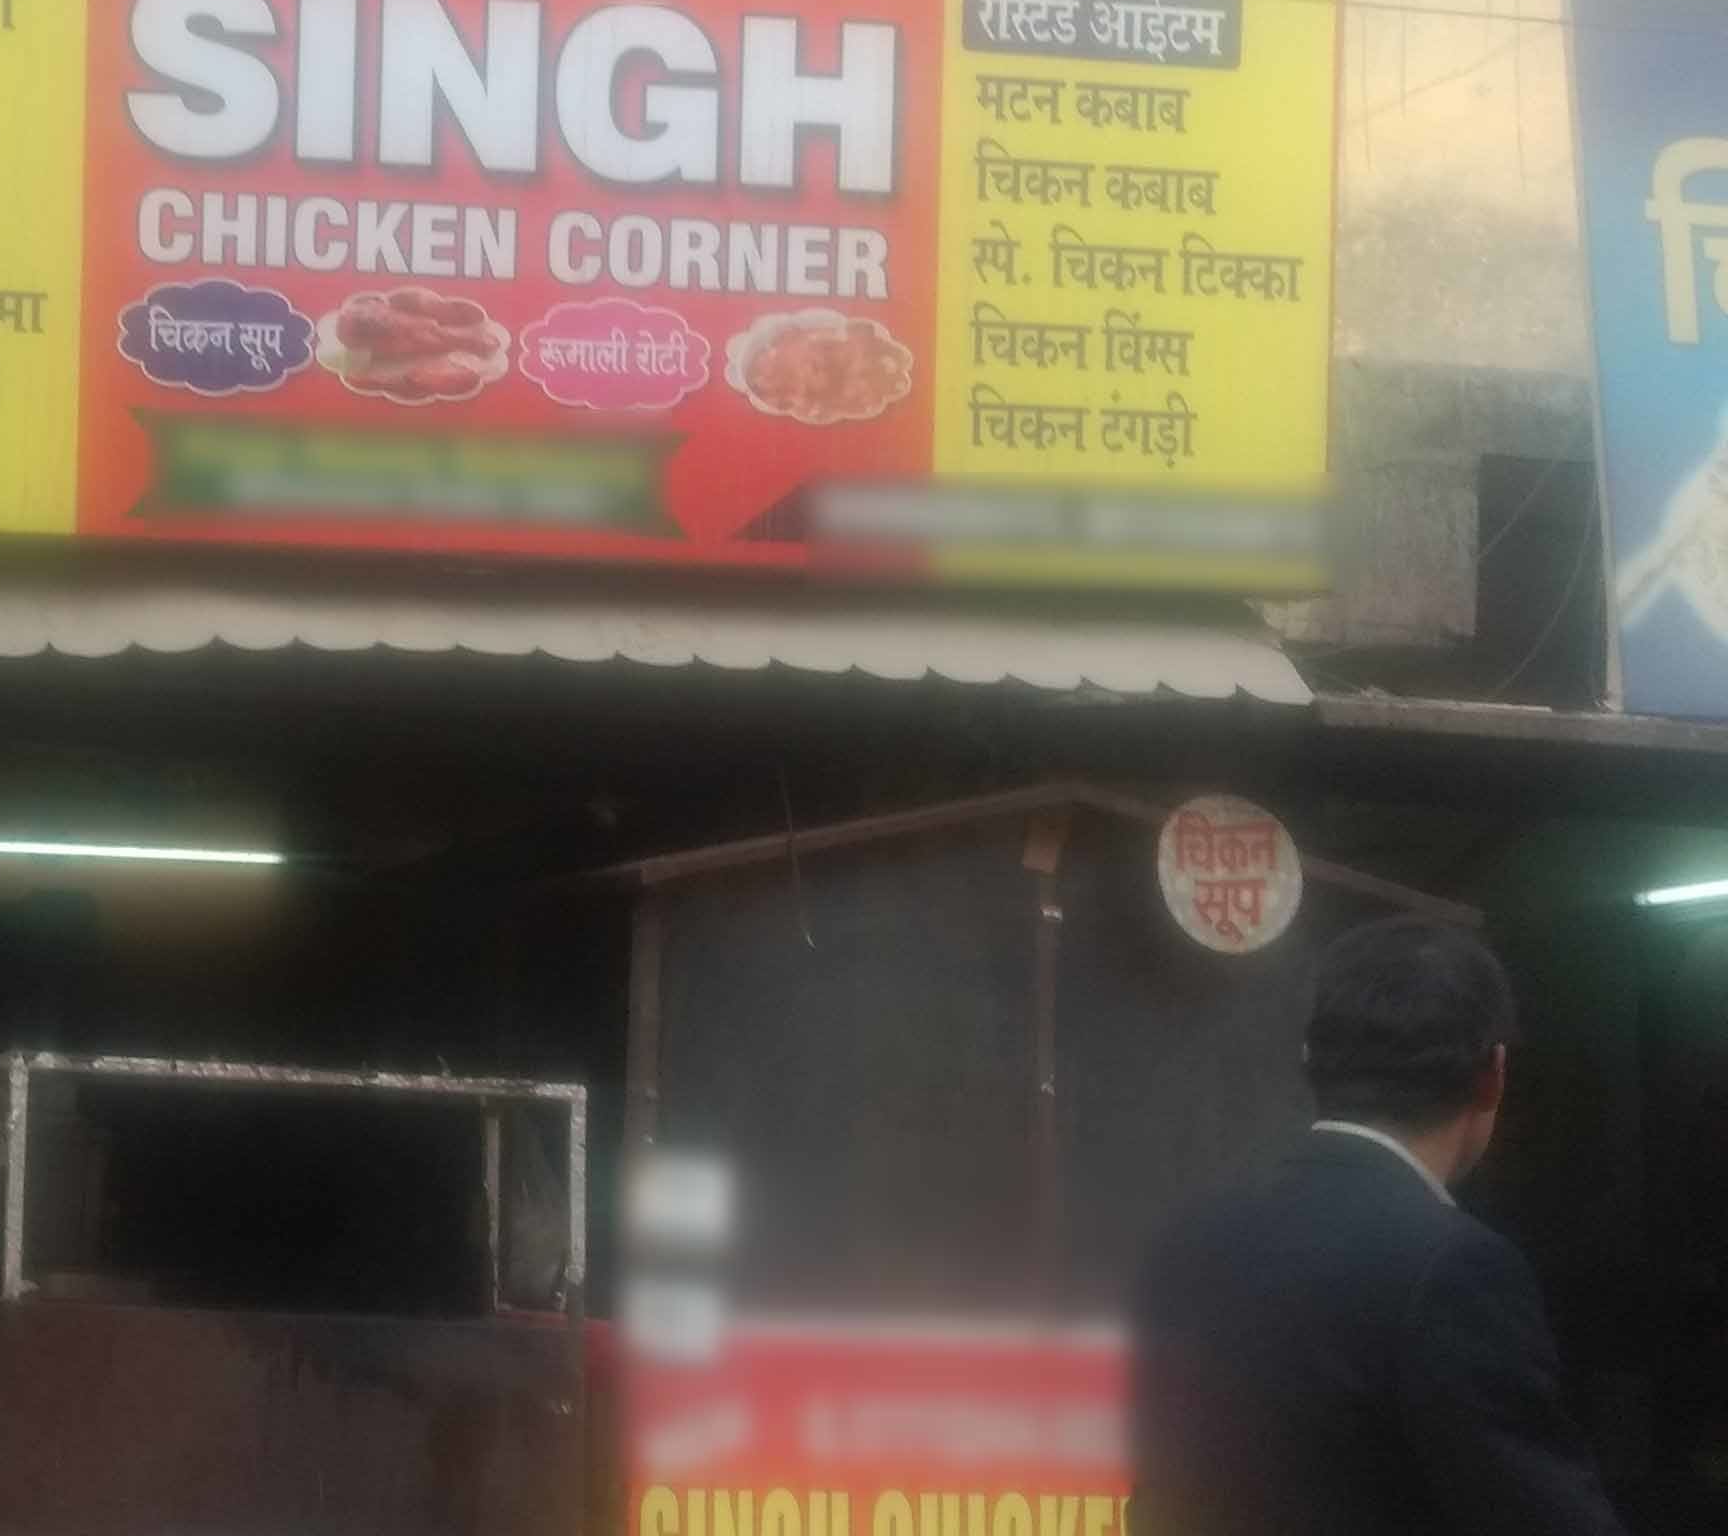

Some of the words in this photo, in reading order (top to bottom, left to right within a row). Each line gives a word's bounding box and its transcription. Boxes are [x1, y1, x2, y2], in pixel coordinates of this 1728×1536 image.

[975, 73, 1067, 125] मटन
[1075, 80, 1191, 135] कबाब
[974, 140, 1094, 209] चिकन
[1105, 161, 1220, 216] कबाब
[137, 186, 519, 279] CHICKEN
[547, 209, 890, 300] CORNER
[1049, 224, 1169, 295] चिकन
[1179, 231, 1304, 302] टिक्का
[149, 307, 235, 357] चिकन
[239, 319, 285, 372] सूप
[969, 302, 1092, 372] चिकन
[968, 382, 1088, 451] चिकन
